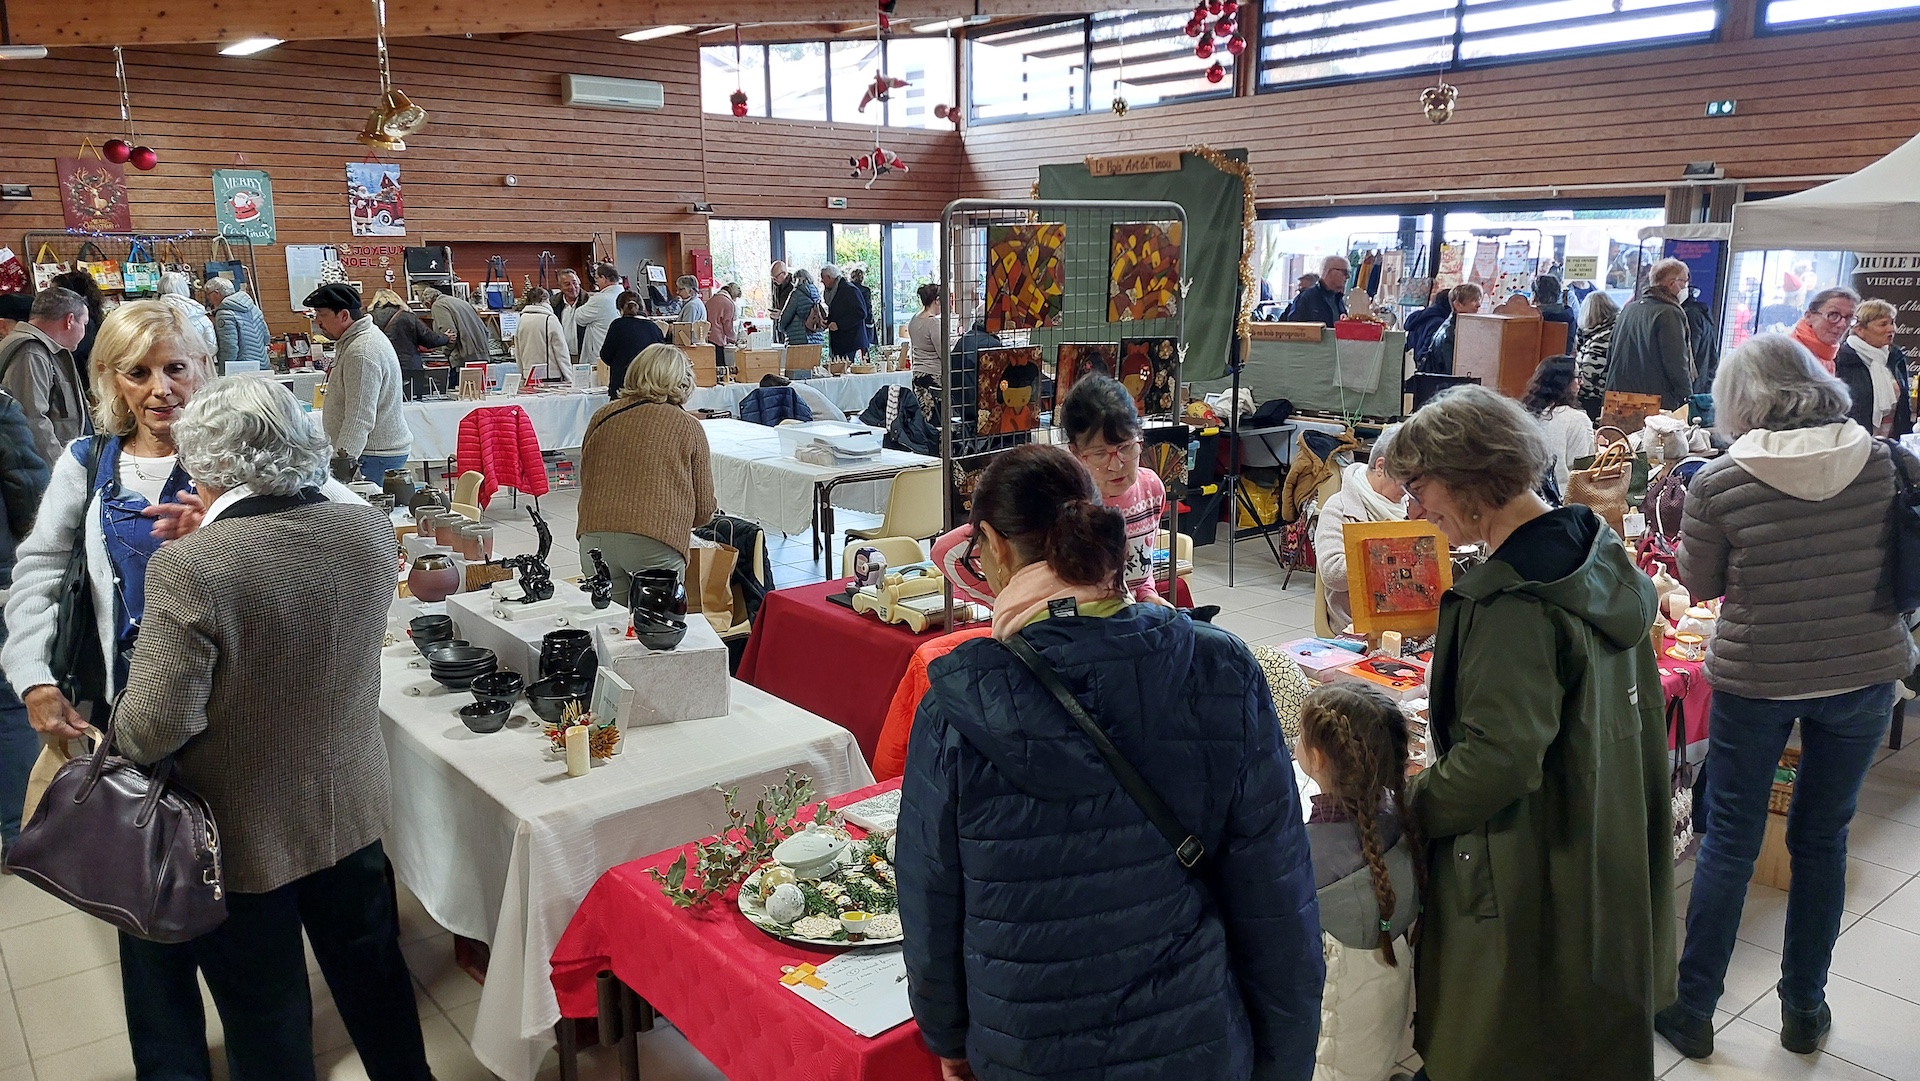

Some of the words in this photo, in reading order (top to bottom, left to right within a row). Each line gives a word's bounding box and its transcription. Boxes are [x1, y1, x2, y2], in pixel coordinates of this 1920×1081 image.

[1140, 157, 1150, 169] de
[223, 177, 263, 192] MERRY
[352, 245, 405, 256] JOYEUX
[340, 256, 377, 268] NOEL
[1860, 257, 1908, 269] HUILE
[1866, 277, 1912, 286] VIERGE
